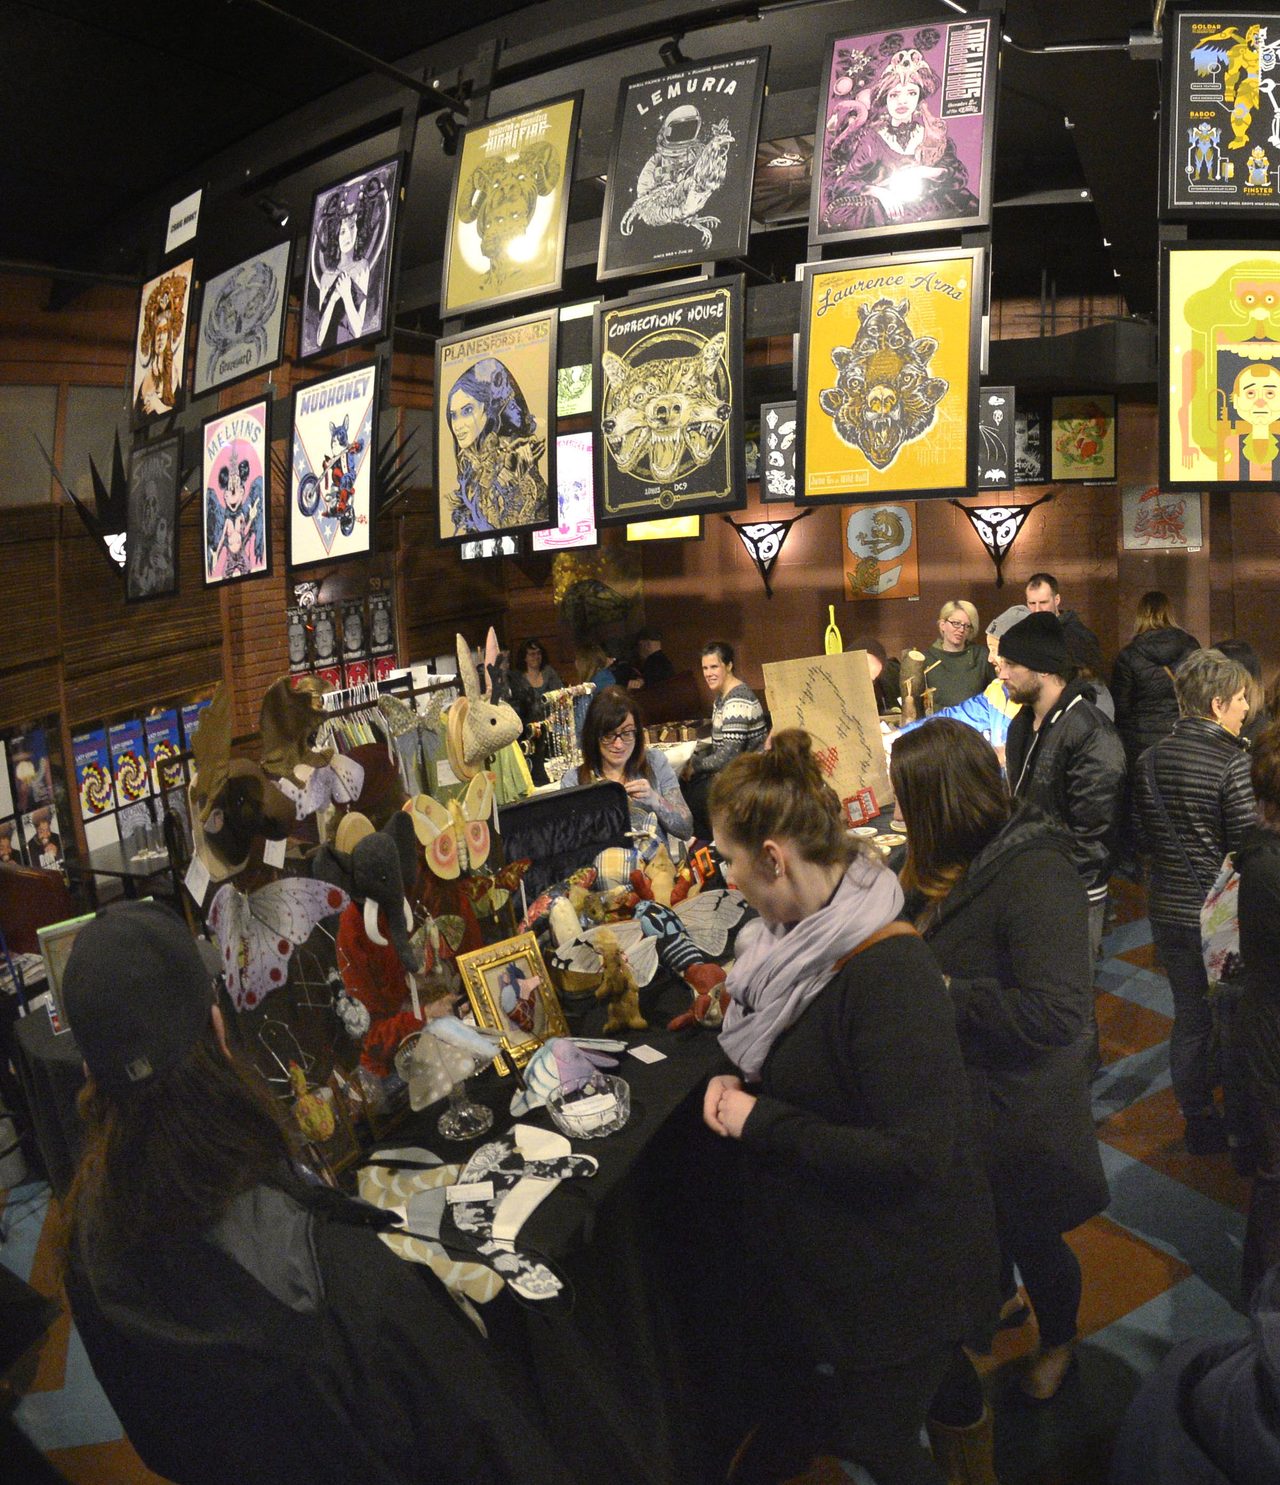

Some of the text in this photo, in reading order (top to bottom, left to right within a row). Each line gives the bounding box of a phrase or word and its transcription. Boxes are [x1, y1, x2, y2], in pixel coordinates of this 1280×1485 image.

[636, 77, 737, 116] LEMURIA
[816, 275, 905, 317] Lawrence
[910, 272, 963, 301] Arms
[609, 302, 724, 338] CORRECTIONS HOUSE
[300, 376, 371, 416] MUDHONEY
[207, 419, 262, 460] MELVINS
[673, 482, 688, 492] DC9
